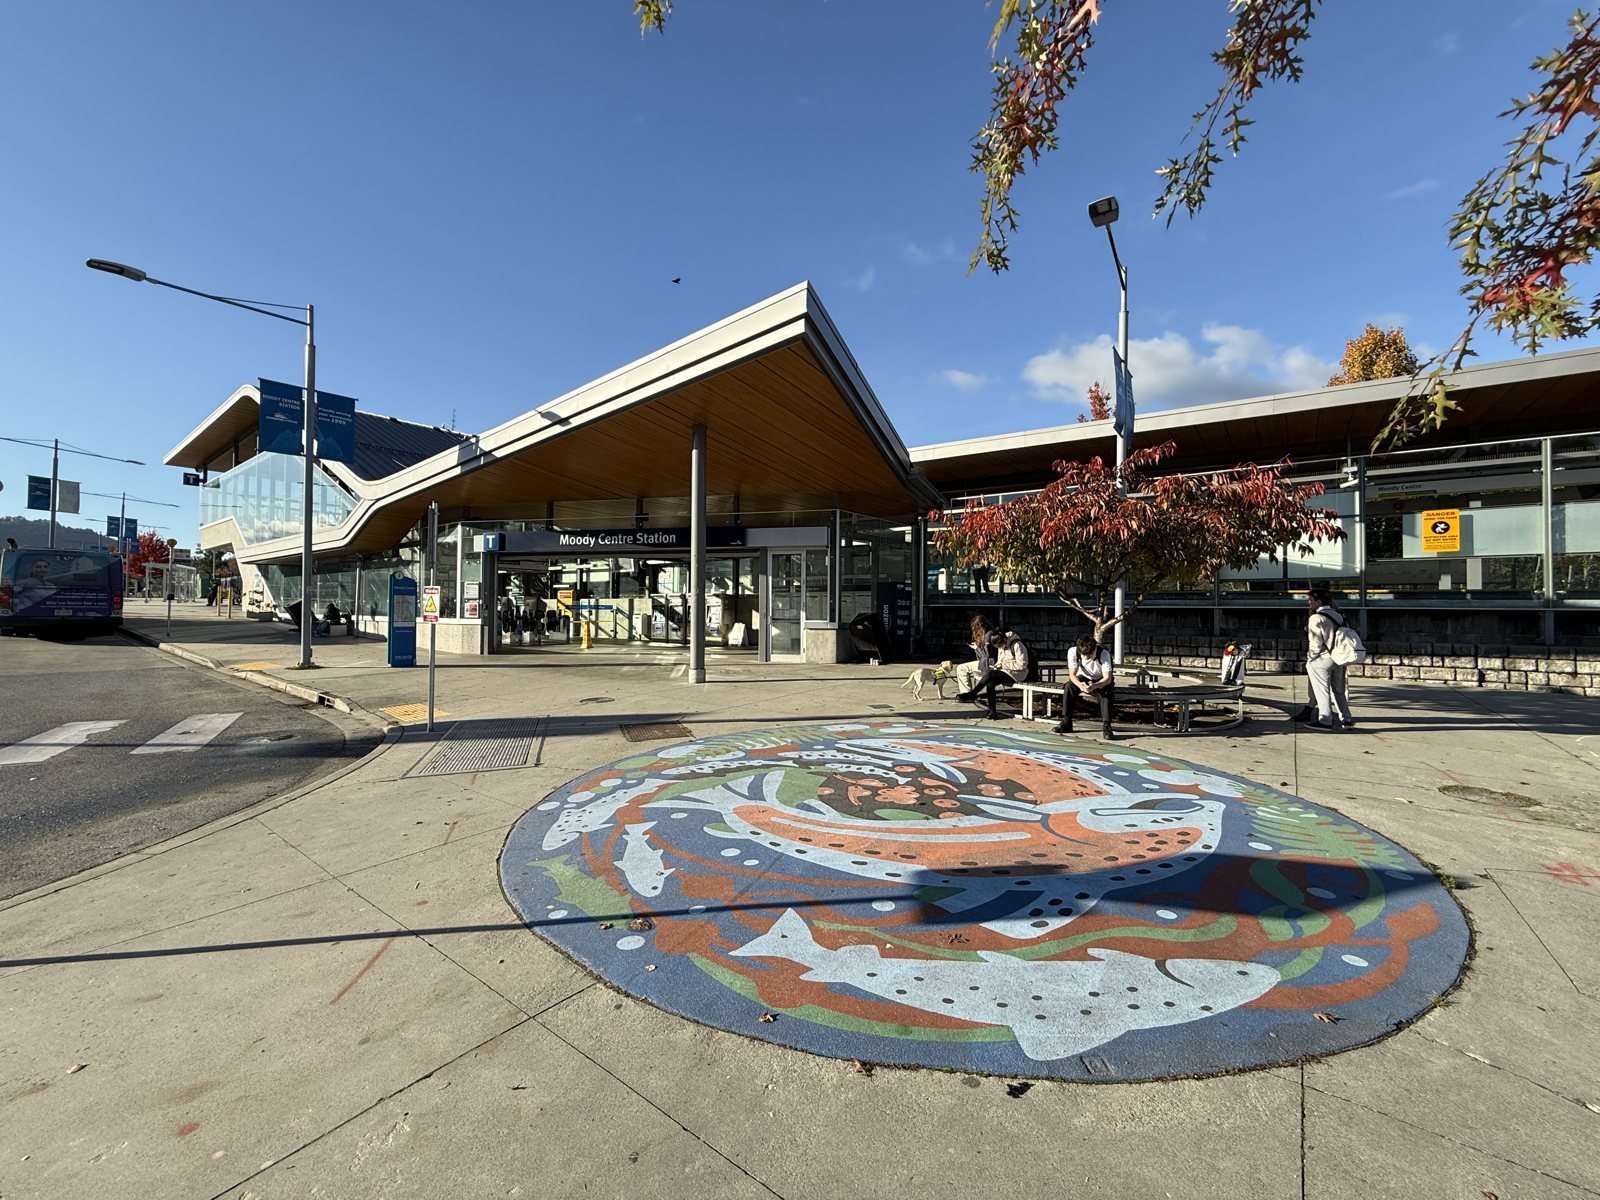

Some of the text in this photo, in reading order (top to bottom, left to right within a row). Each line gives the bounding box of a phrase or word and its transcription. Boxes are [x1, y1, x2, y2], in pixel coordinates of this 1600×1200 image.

[279, 402, 300, 410] STATION
[485, 535, 496, 549] T
[559, 532, 676, 548] Moody Centre Station
